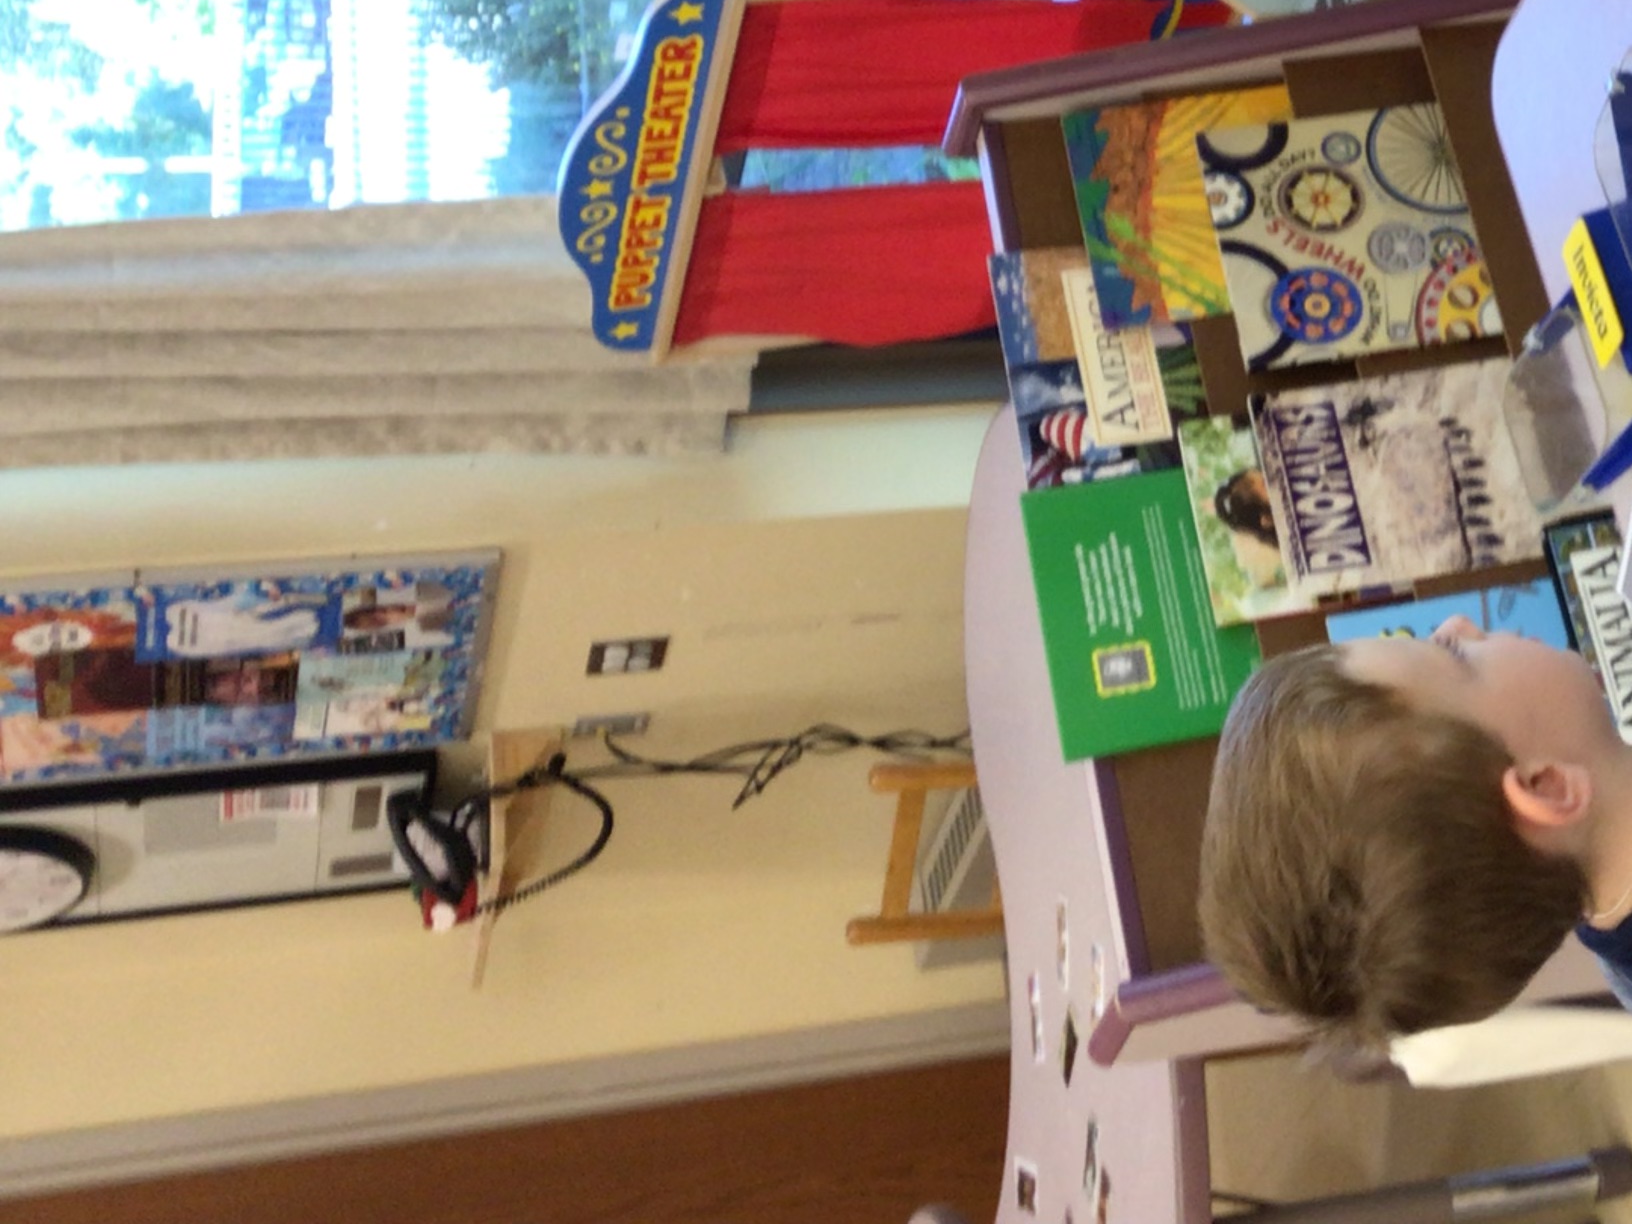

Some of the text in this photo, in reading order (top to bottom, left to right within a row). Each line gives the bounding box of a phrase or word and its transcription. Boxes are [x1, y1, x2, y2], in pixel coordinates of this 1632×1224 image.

[609, 34, 703, 310] PUPPET THEATER
[1265, 216, 1366, 281] WHEELS
[1276, 404, 1369, 571] DINOSAURS
